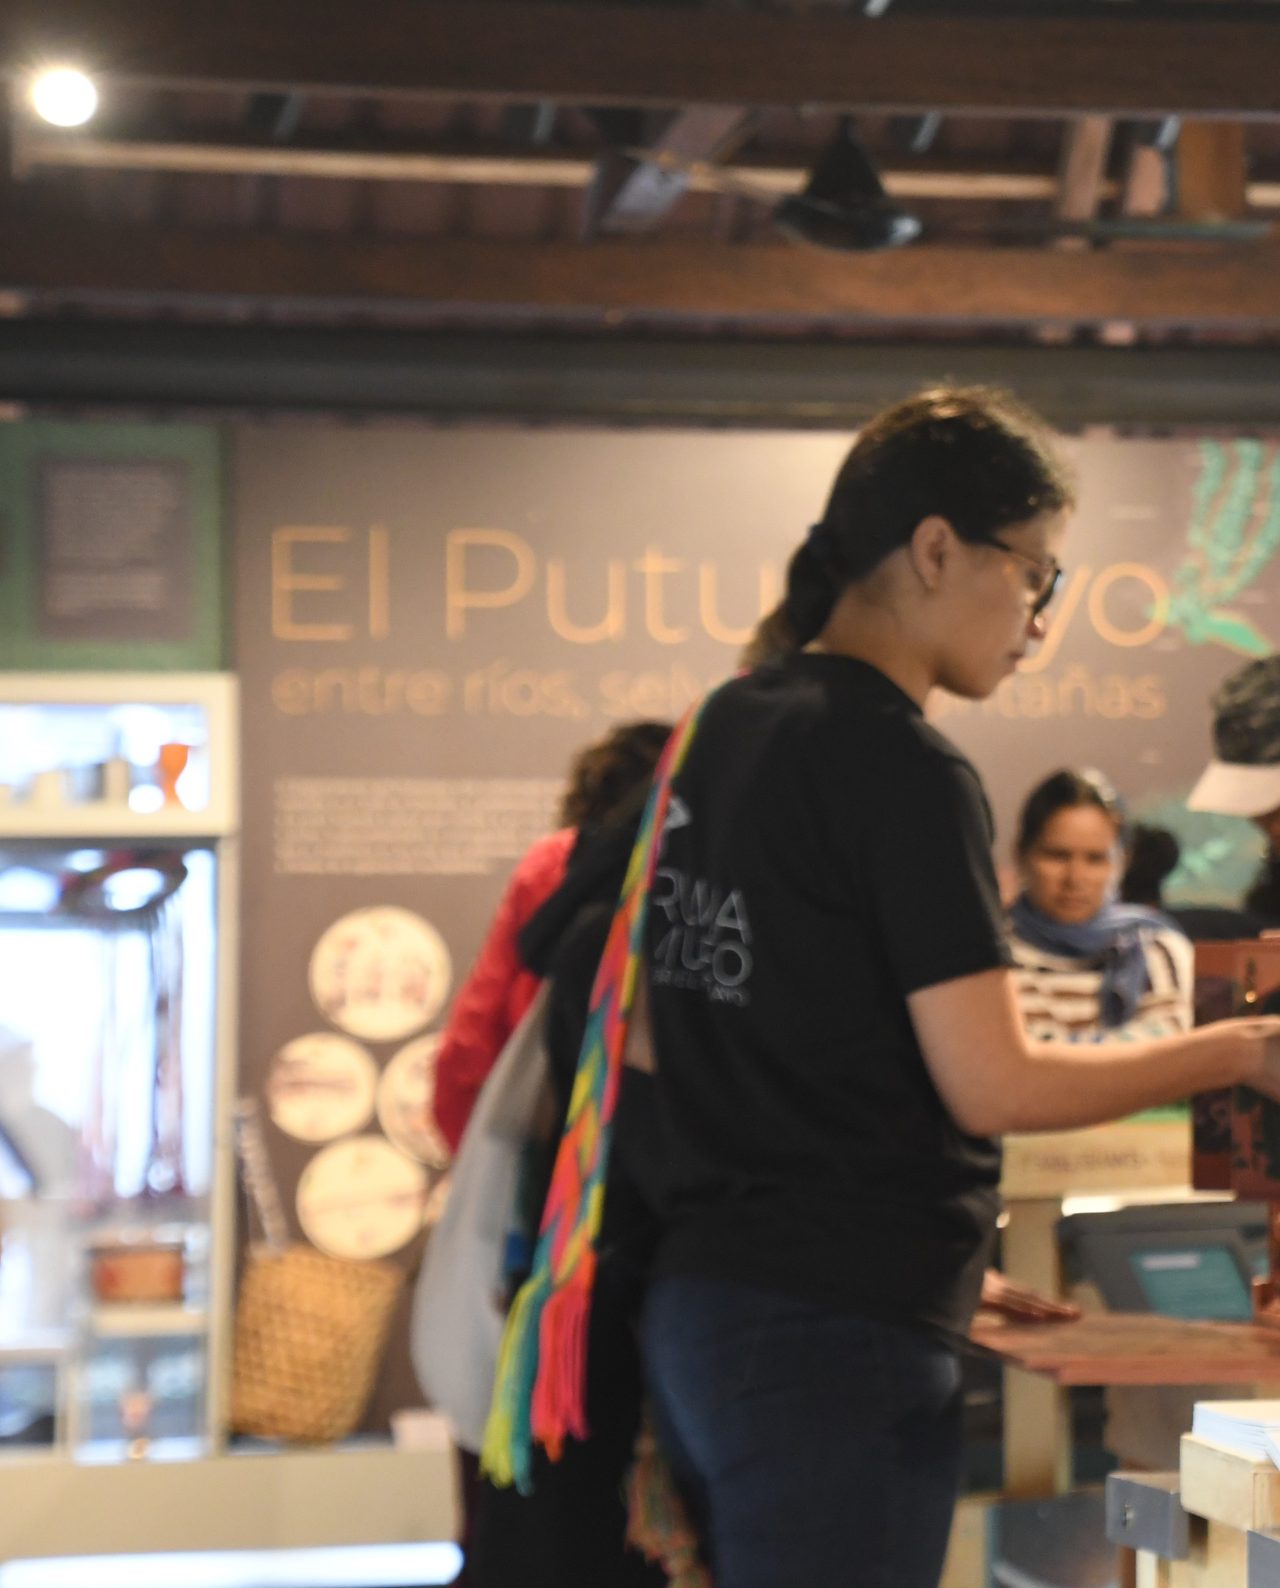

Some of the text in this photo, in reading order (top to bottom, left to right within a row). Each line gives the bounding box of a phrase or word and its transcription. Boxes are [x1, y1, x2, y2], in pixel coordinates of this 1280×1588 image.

[271, 524, 391, 642] El
[444, 526, 1170, 674] Putuyo
[271, 664, 450, 717] entre
[463, 657, 592, 722] ríos,
